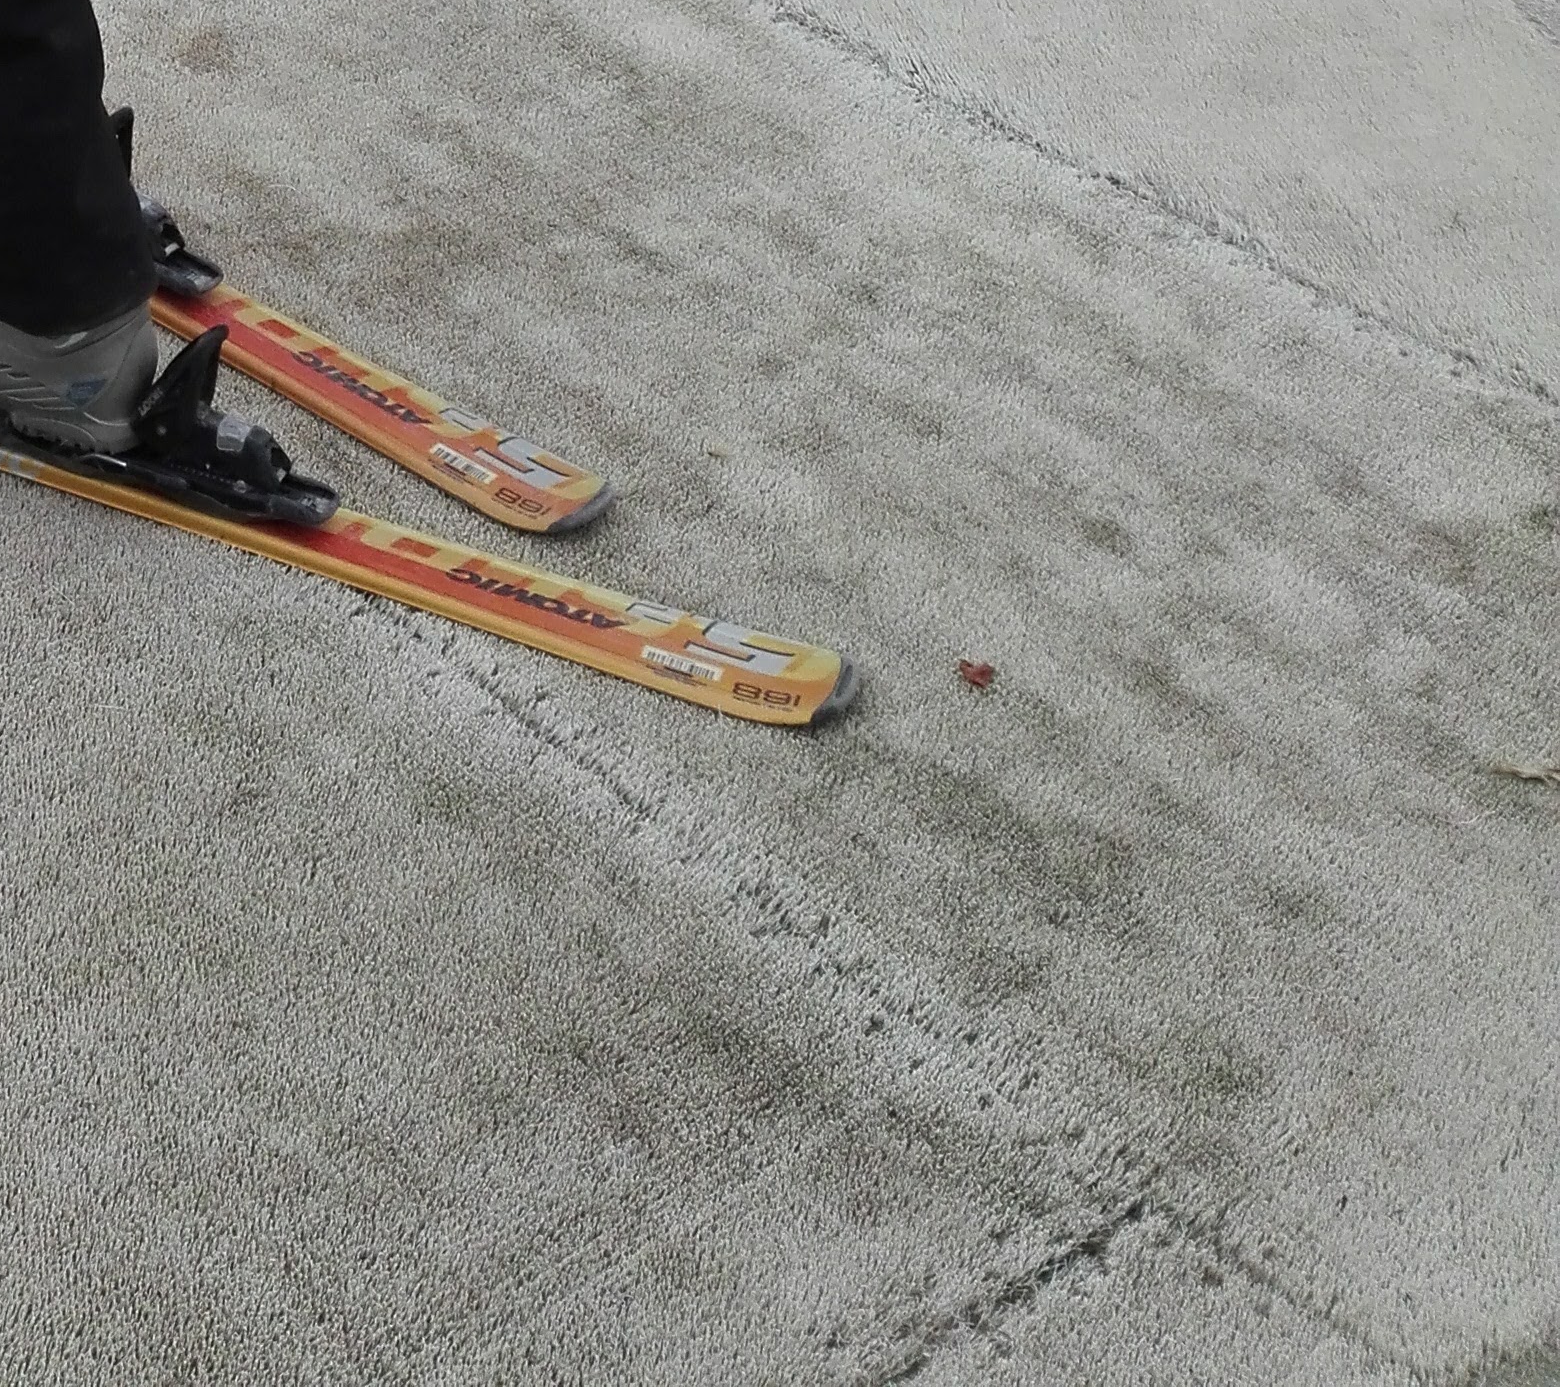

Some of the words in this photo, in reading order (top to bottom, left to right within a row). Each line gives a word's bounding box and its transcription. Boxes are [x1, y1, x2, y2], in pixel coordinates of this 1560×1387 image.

[289, 349, 432, 426] ATOMIC
[443, 566, 633, 629] ATOMIC
[731, 681, 802, 708] 168
